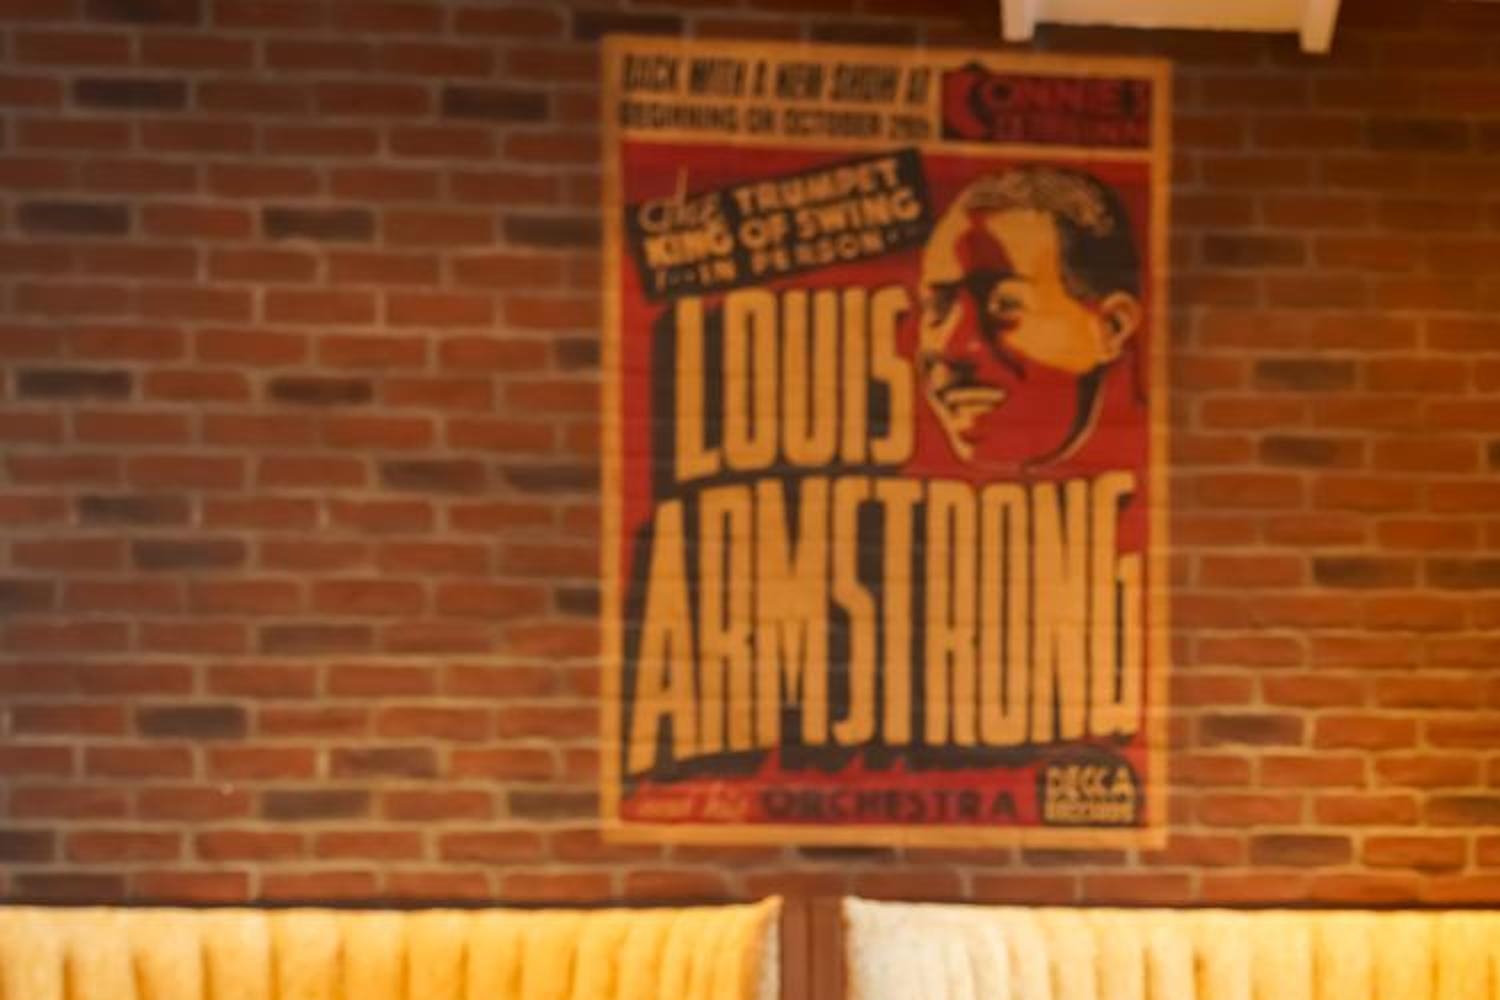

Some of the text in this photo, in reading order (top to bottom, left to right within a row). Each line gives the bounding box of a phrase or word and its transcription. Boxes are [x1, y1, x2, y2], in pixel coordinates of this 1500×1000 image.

[732, 157, 899, 215] TRUMPET
[644, 187, 920, 268] KING OF SWING
[675, 287, 915, 484] LOUIS
[627, 471, 1143, 776] ARMSTRONG
[762, 786, 1018, 820] ORCHESTRA
[1045, 764, 1136, 800] DECCA
